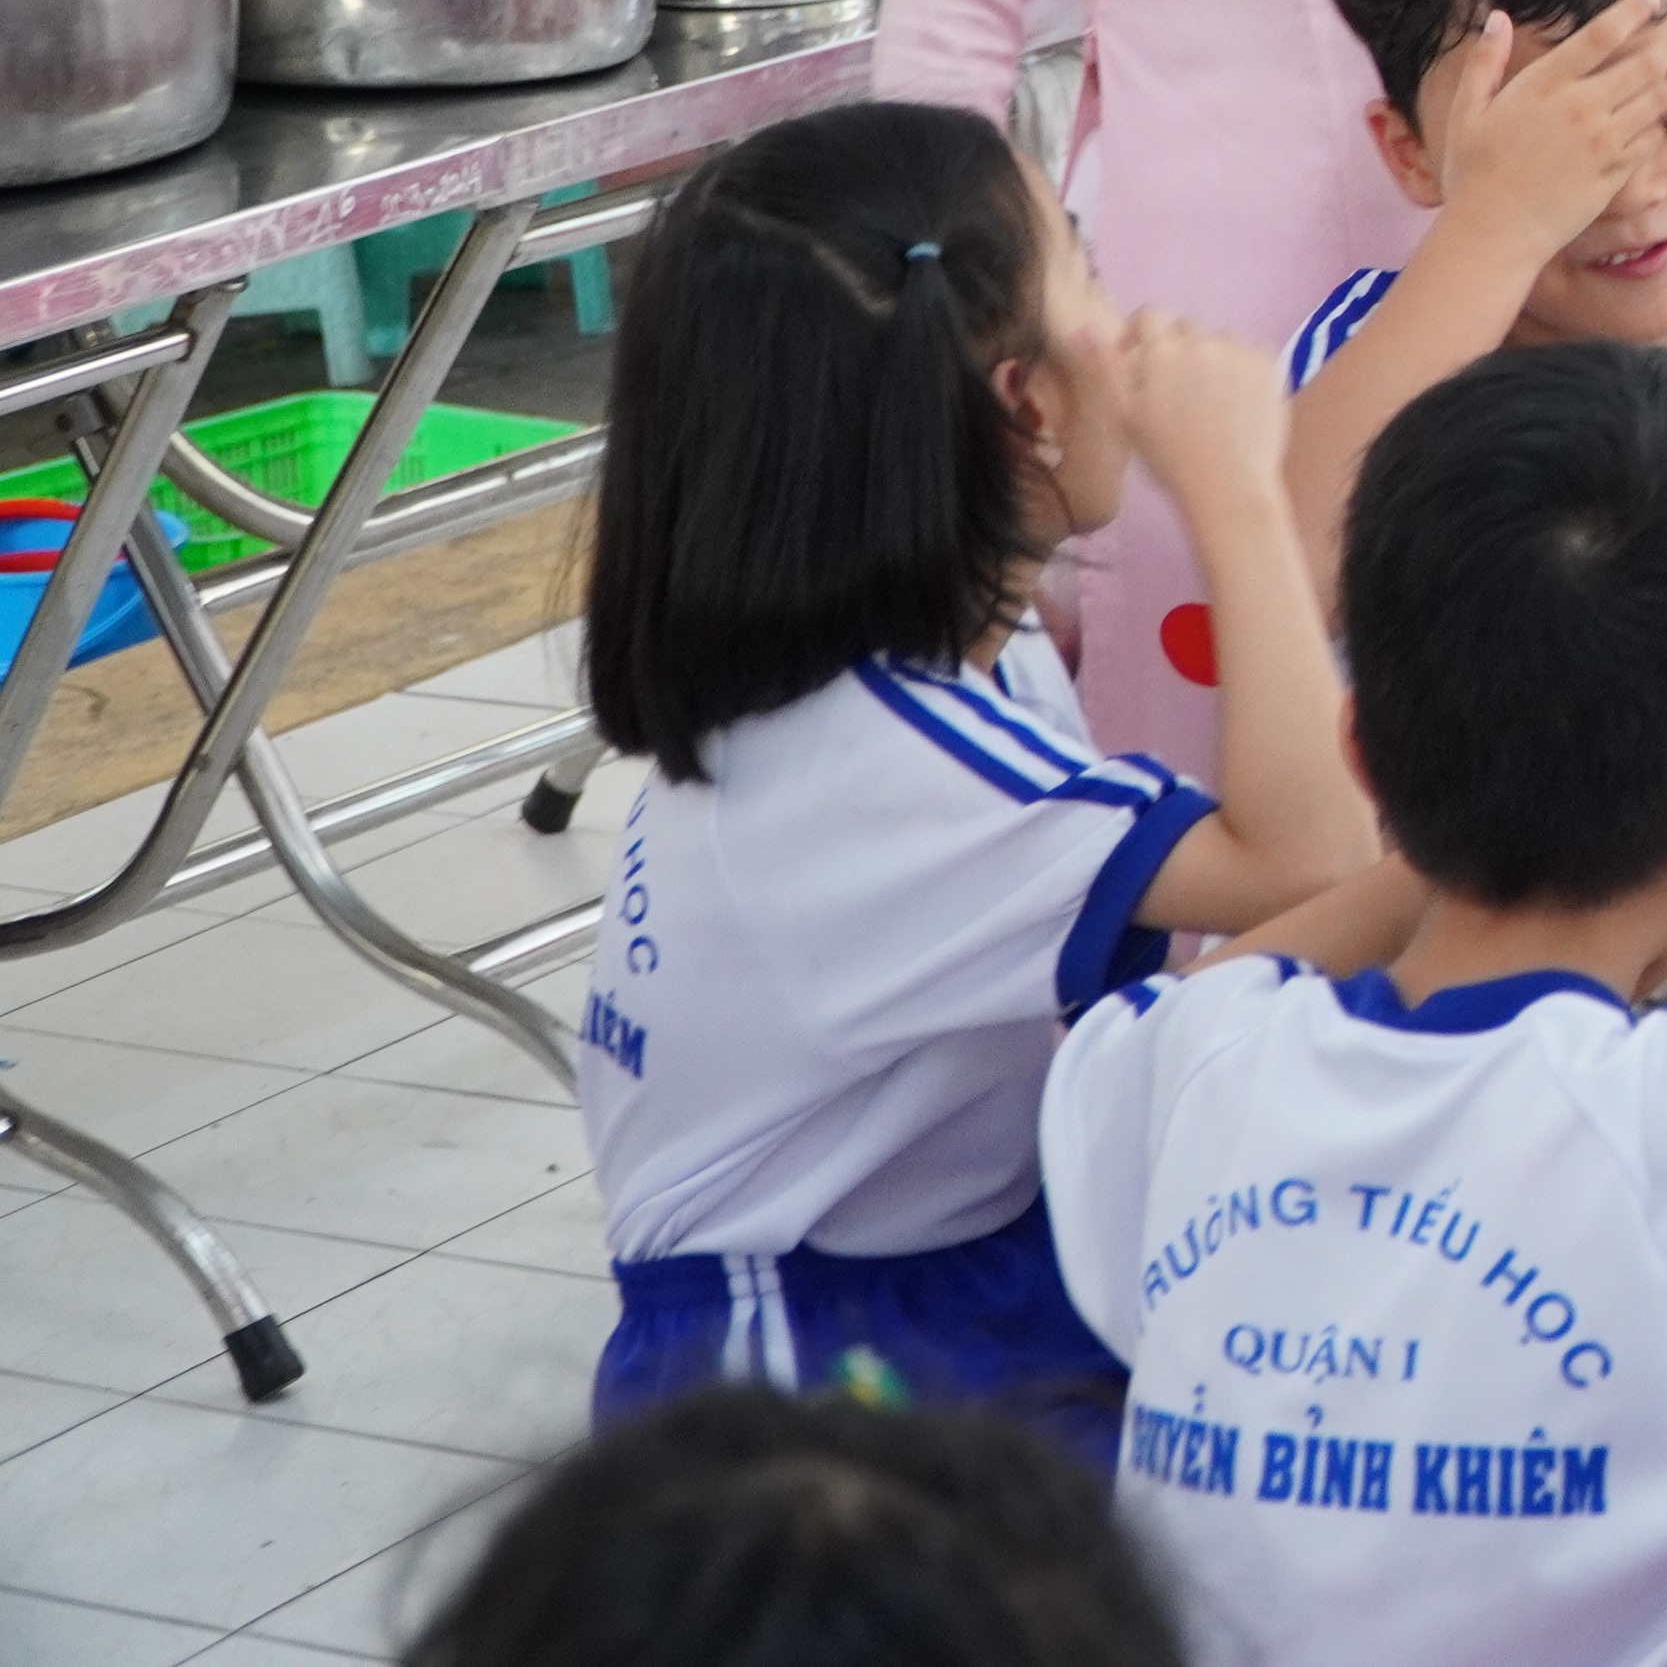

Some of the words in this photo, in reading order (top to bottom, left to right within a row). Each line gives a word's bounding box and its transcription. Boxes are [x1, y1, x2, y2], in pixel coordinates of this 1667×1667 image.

[1143, 1176, 1318, 1311] RƯỜNG
[1480, 1248, 1613, 1389] HỌC
[1224, 1322, 1383, 1386] QUẬN
[1412, 1426, 1609, 1518] KHIÊM
